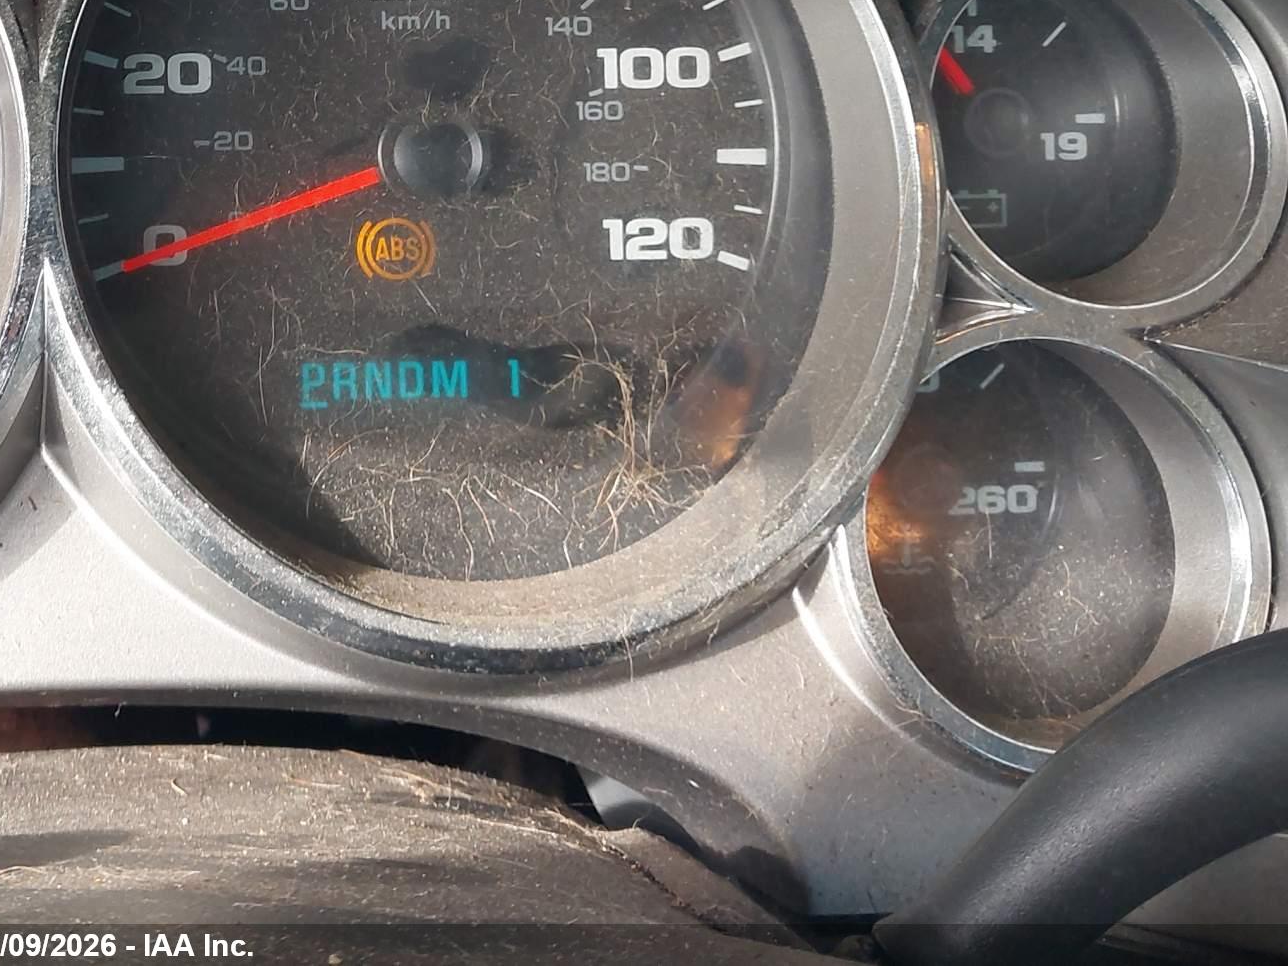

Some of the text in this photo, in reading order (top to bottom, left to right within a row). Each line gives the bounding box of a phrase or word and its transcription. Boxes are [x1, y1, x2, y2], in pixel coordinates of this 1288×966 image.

[380, 10, 451, 31] km/h
[545, 16, 593, 37] 140
[951, 24, 998, 54] 14
[123, 52, 212, 95] 20
[226, 56, 267, 77] 40
[596, 47, 711, 90] 100
[576, 101, 623, 122] 160
[213, 131, 254, 152] 20
[1040, 132, 1088, 161] 19
[584, 162, 631, 183] 180
[143, 225, 190, 267] 0
[374, 238, 420, 262] ABS
[602, 218, 715, 261] 120
[948, 484, 1039, 515] 260
